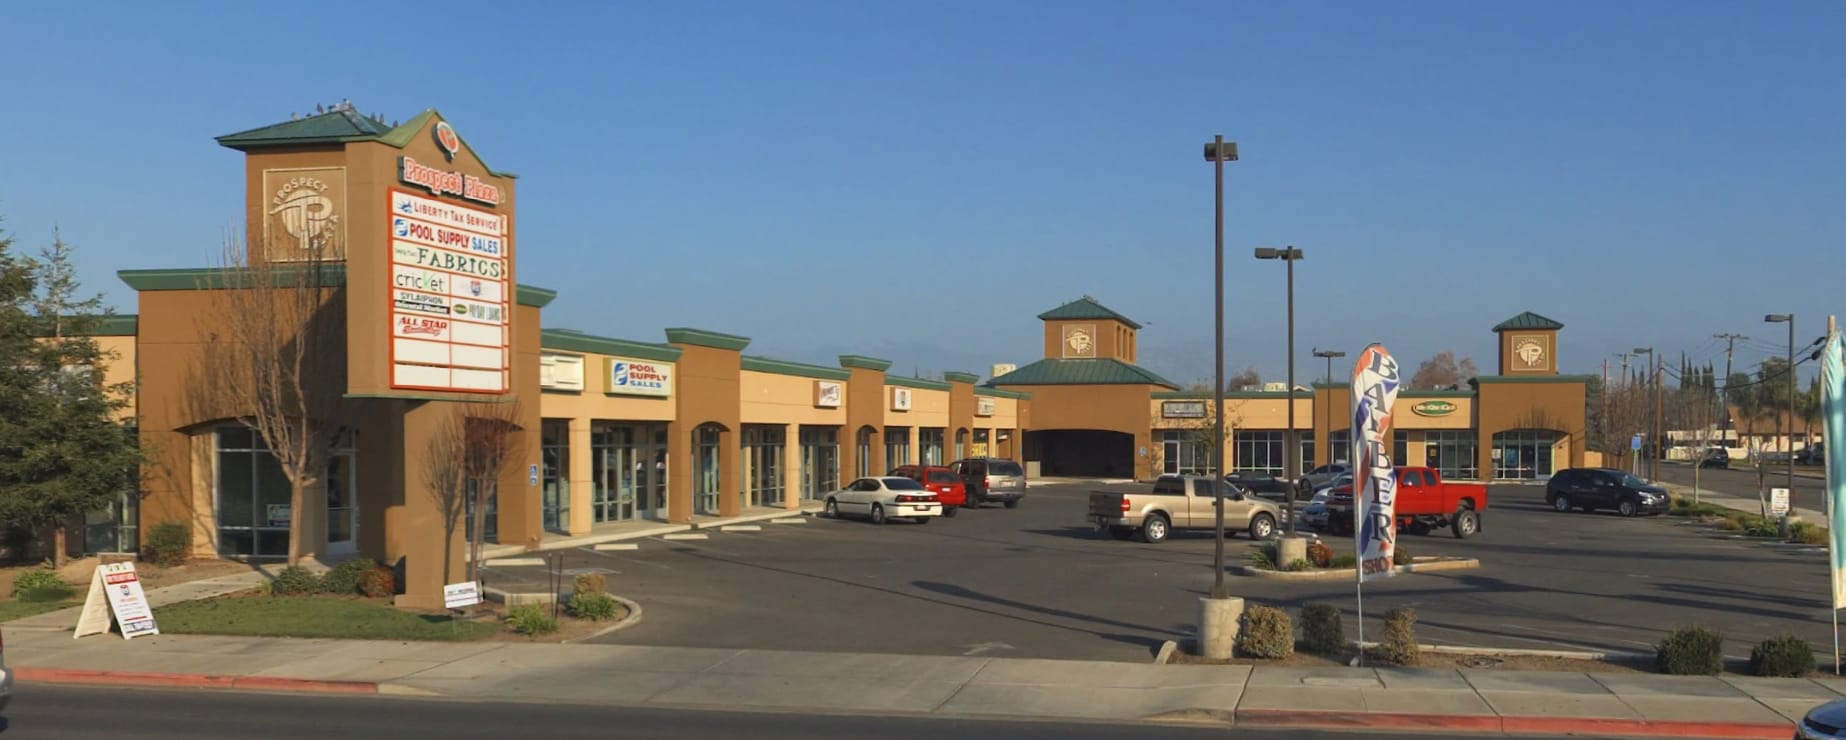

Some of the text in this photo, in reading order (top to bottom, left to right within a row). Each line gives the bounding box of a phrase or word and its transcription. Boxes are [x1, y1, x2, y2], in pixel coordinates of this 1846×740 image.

[403, 157, 463, 195] Prospect
[272, 177, 328, 205] PROSPECT
[414, 204, 448, 219] LIBERTY
[466, 213, 498, 231] SERVICE
[410, 222, 499, 254] POOL SUPPLY SALES
[416, 247, 500, 278] FABRICS
[396, 271, 445, 292] cricket
[400, 316, 448, 329] ALL STAR
[629, 364, 656, 373] POOL
[629, 372, 668, 381] SUPPLY
[630, 380, 662, 388] SALES
